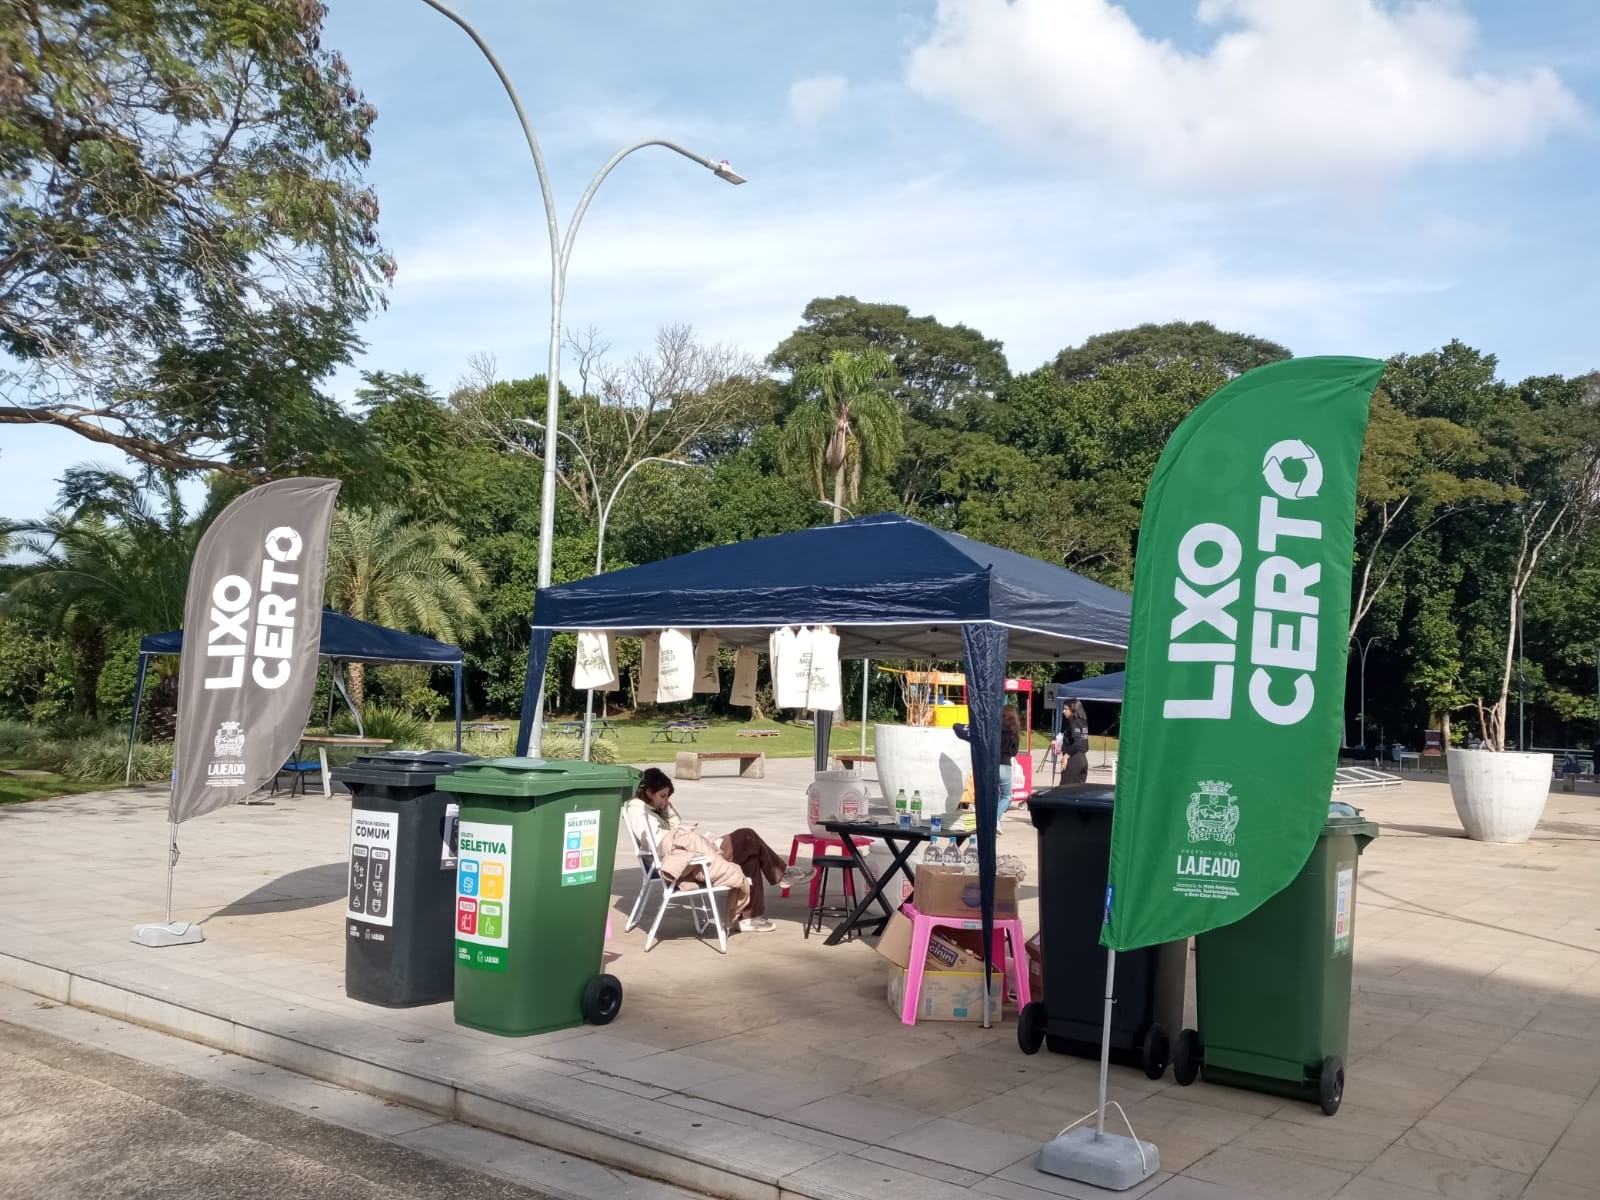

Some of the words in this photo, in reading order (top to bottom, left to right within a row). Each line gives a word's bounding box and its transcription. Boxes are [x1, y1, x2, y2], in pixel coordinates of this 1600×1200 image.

[1247, 437, 1325, 726] CERTO
[251, 525, 304, 690] CERTO
[205, 574, 252, 689] LIXO
[1163, 522, 1243, 720] LIXO
[208, 763, 245, 775] LAJEADO
[355, 826, 390, 840] COMUM
[568, 818, 597, 828] SELETIVA
[460, 838, 507, 855] SELETIVA
[1177, 855, 1240, 879] LAJEADO
